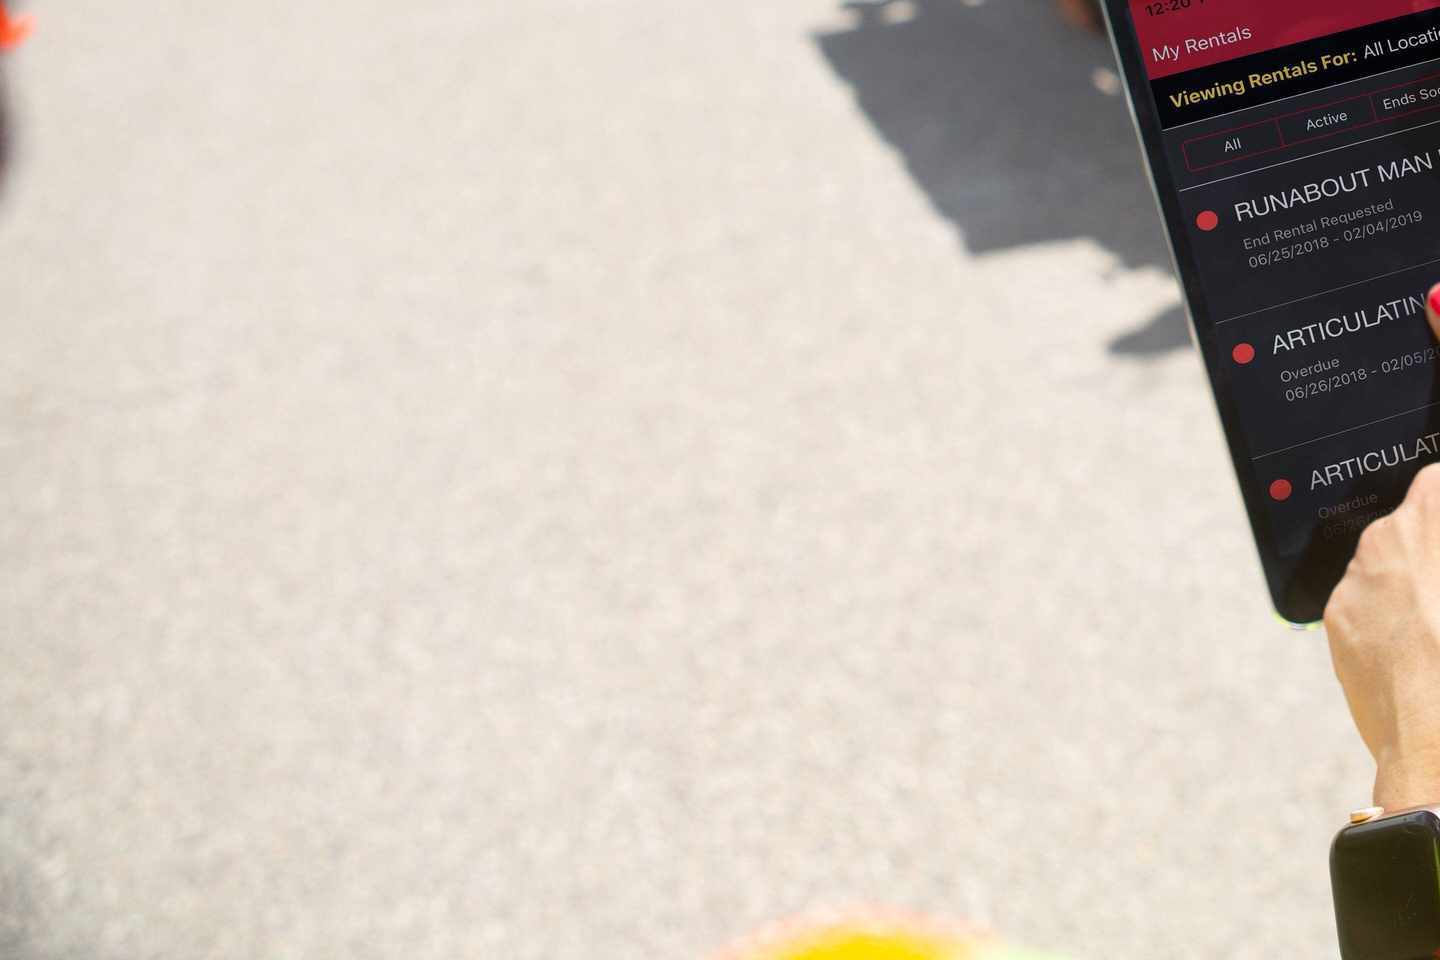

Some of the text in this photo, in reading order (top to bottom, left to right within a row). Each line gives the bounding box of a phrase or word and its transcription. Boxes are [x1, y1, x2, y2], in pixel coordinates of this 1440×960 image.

[1152, 26, 1252, 63] My Rentals
[1168, 78, 1246, 108] Viewing
[1248, 60, 1318, 89] Rentals
[1320, 51, 1358, 70] For:
[1363, 40, 1383, 60] All
[1383, 92, 1417, 110] Ends
[1306, 111, 1348, 132] Active
[1223, 137, 1242, 153] All
[1233, 168, 1371, 223] RUNABOUT
[1376, 152, 1433, 183] MAN
[1243, 199, 1395, 250] End Rental Requested
[1248, 236, 1330, 269] 06/25/2018
[1343, 210, 1423, 243] 02/04/2019
[1272, 293, 1427, 355] ARTICULATIN
[1280, 357, 1340, 383] Overdue
[1285, 368, 1368, 402] 06/26/2018
[1317, 493, 1379, 520] Overdue
